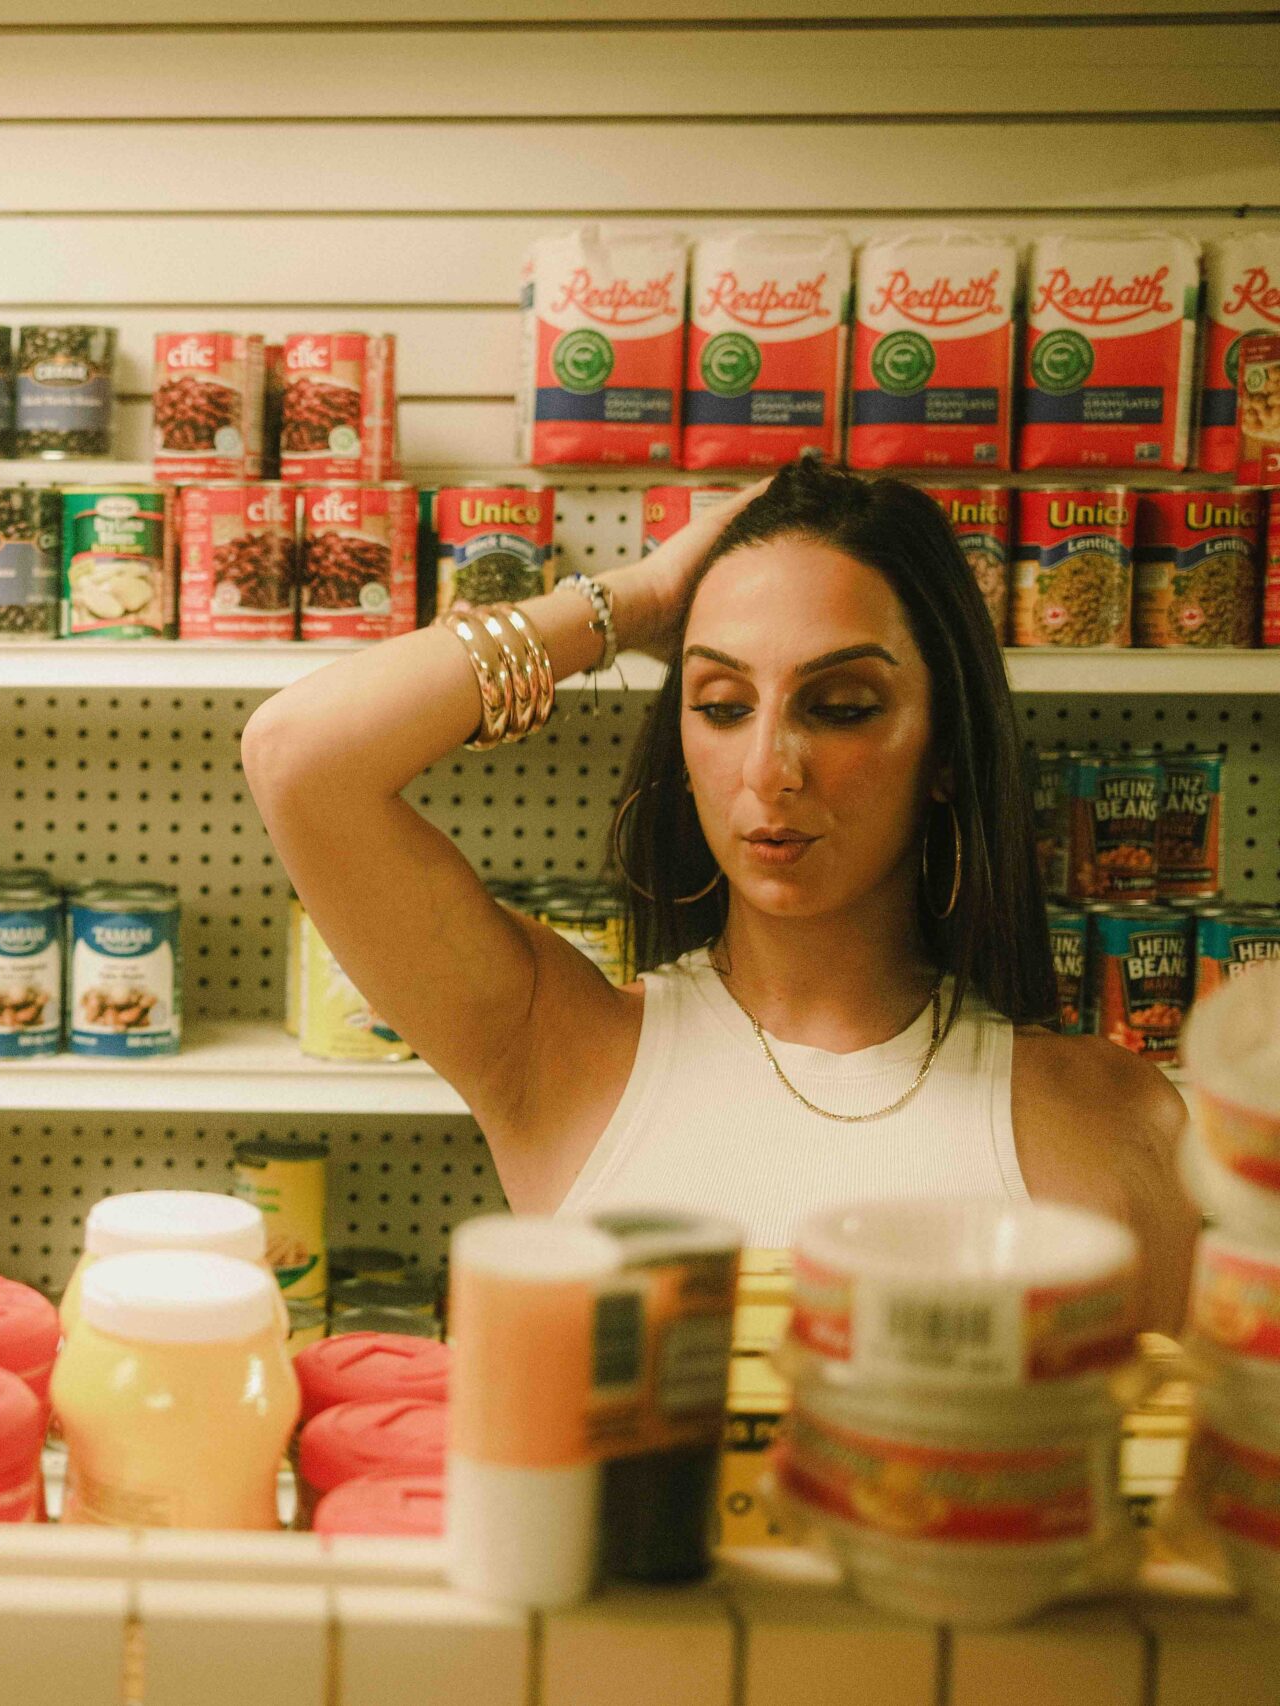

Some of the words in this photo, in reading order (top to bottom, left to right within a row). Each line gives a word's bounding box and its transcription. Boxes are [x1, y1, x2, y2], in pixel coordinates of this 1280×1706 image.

[550, 267, 677, 326] Redpath
[698, 271, 831, 328] Redpath
[868, 266, 1003, 326] Redpath
[1031, 265, 1173, 326] Redpath
[167, 337, 215, 368] clic
[286, 337, 329, 369] clic
[312, 491, 358, 522] clic
[460, 498, 542, 527] Unico
[1049, 500, 1129, 529] Unico
[1105, 780, 1155, 799] HEINZ
[1095, 799, 1158, 821] BEANS
